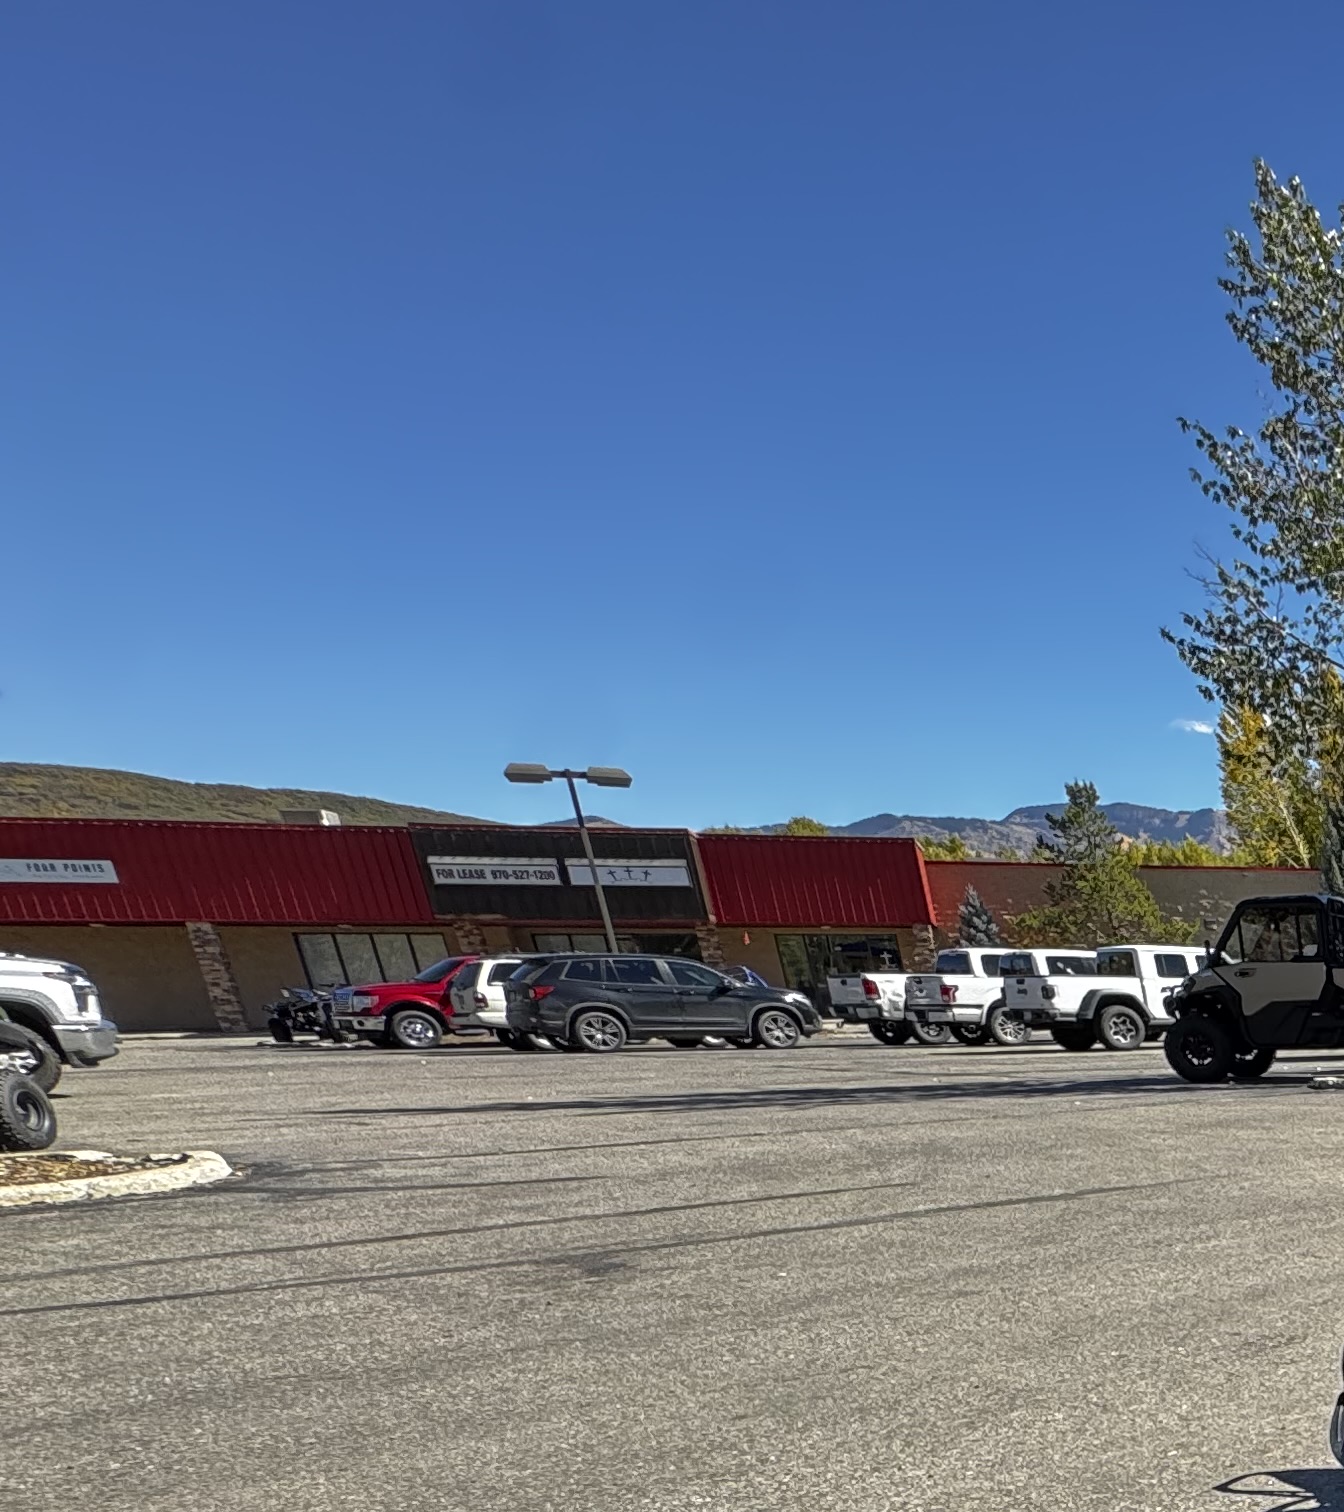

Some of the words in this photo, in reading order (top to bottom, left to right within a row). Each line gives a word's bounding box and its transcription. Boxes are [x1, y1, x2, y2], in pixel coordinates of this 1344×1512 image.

[62, 864, 105, 873] POINTS
[435, 868, 456, 879] FOR
[456, 868, 487, 879] LEASE
